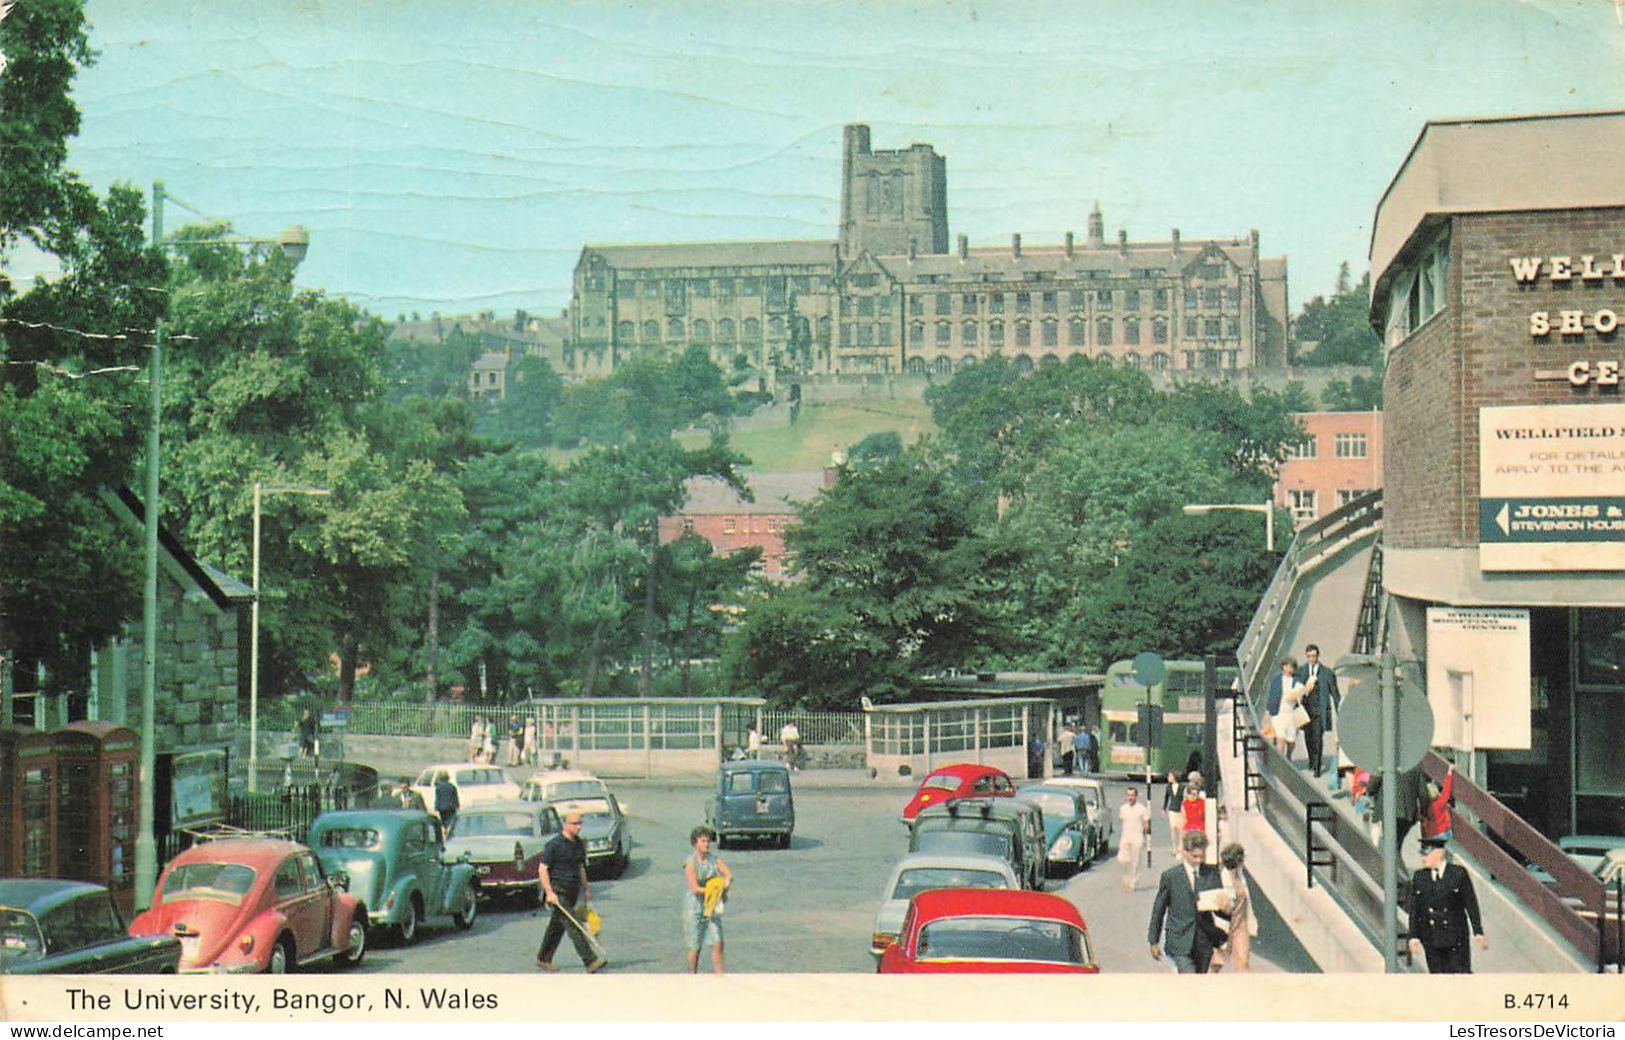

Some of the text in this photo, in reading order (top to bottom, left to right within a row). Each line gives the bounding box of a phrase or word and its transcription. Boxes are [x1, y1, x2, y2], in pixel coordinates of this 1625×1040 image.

[1510, 254, 1625, 281] WELL
[1530, 308, 1617, 336] SHO
[1568, 361, 1619, 385] CE
[1496, 428, 1615, 439] WELLFIELD
[1529, 451, 1558, 461] FOR
[1495, 463, 1540, 474] APPLY
[1549, 464, 1568, 473] TO
[1576, 463, 1602, 473] THE
[1514, 505, 1622, 518] JONES &
[1511, 520, 1625, 531] STEVENSON HOUS
